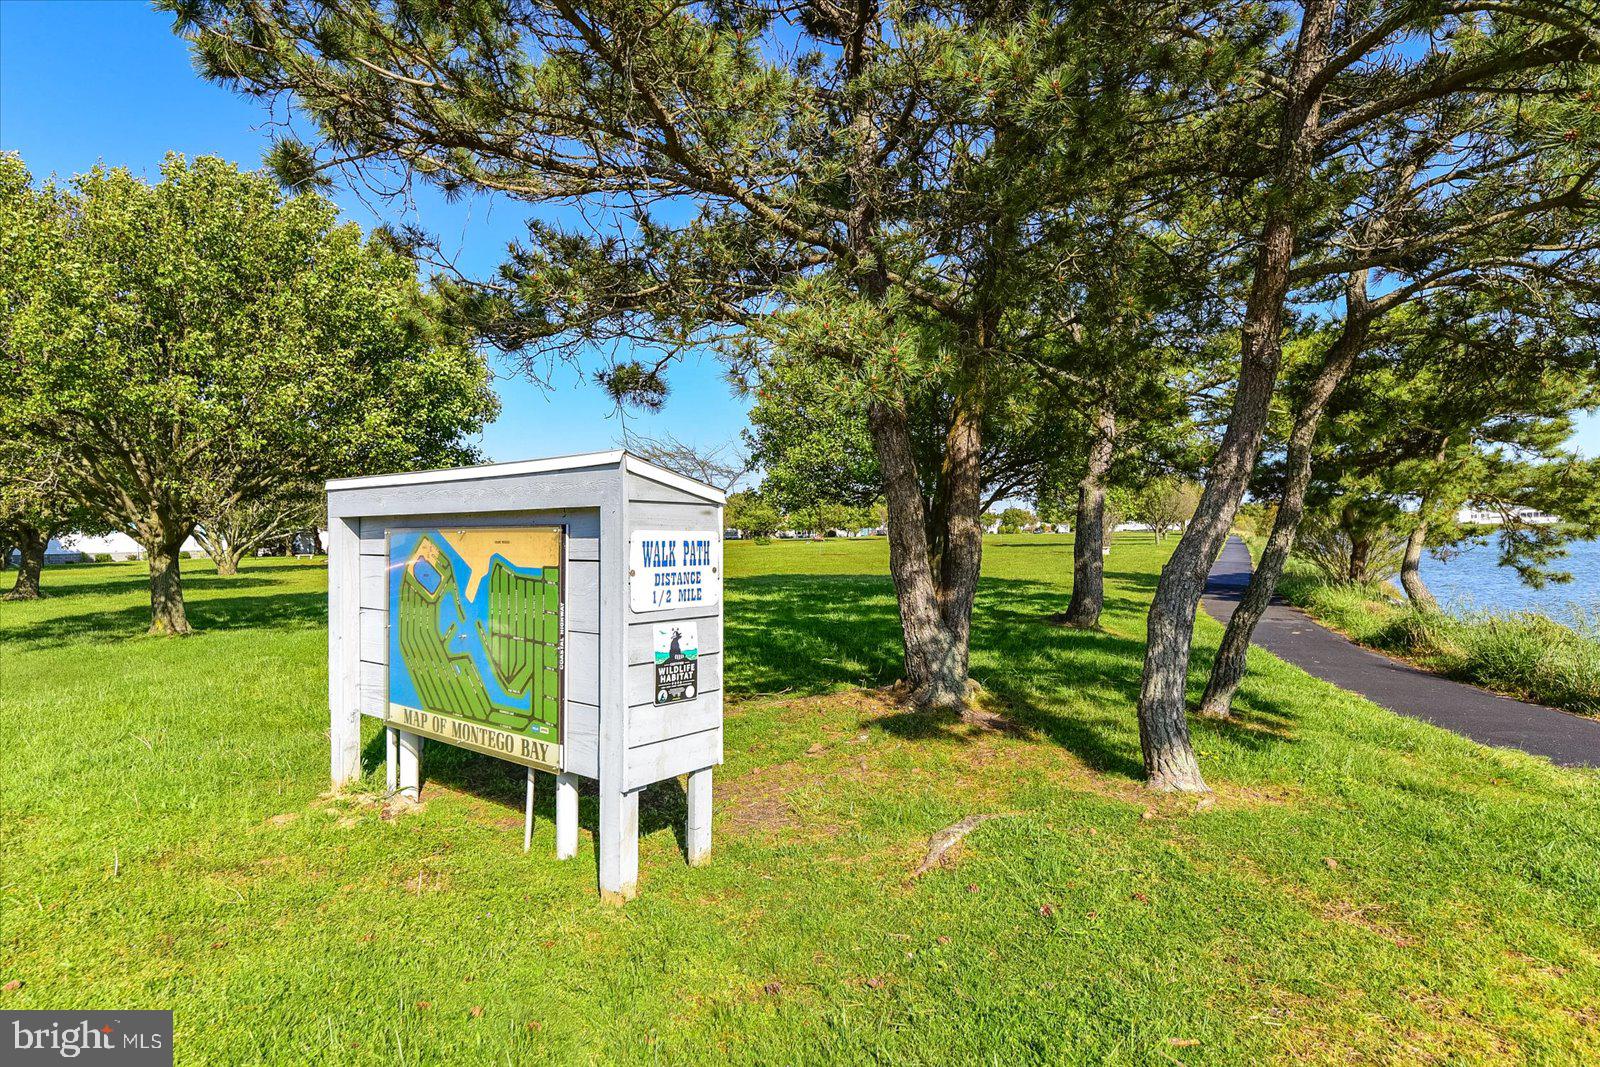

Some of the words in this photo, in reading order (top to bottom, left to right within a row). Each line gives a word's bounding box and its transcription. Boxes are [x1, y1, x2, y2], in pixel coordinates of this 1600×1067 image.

[642, 540, 676, 568] WALK
[683, 540, 710, 567] PATH
[654, 571, 702, 587] DISTANCE
[653, 589, 671, 607] 1/2
[678, 587, 702, 602] MILE
[658, 663, 695, 676] WILDLIFE
[660, 671, 694, 684] HABITAT
[403, 708, 428, 729] MAP
[432, 715, 447, 734] OF
[451, 721, 514, 754] MONTEGO
[520, 737, 549, 763] BAY
